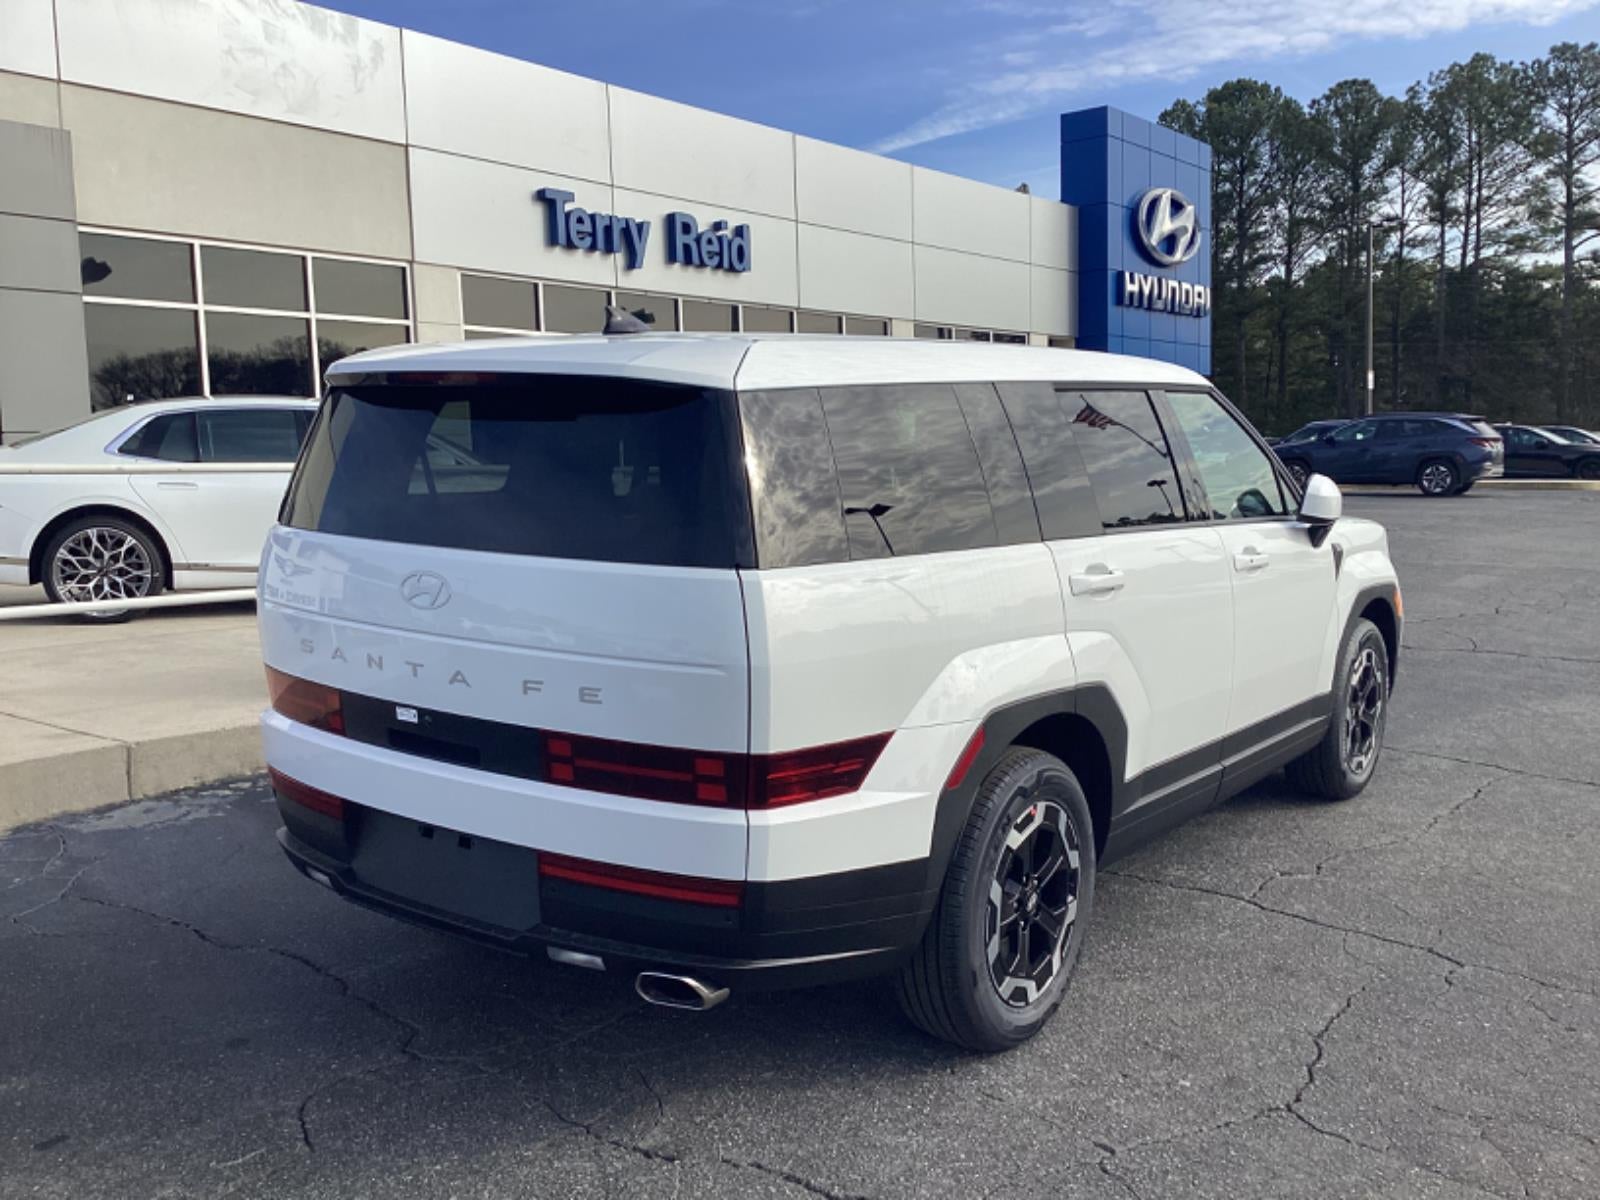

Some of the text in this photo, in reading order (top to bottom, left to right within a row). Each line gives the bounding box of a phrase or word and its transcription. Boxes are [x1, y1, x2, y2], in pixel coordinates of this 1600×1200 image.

[535, 187, 751, 272] Terry Reid
[1121, 270, 1211, 317] HYUNDAI
[300, 637, 604, 705] SANTA FE
